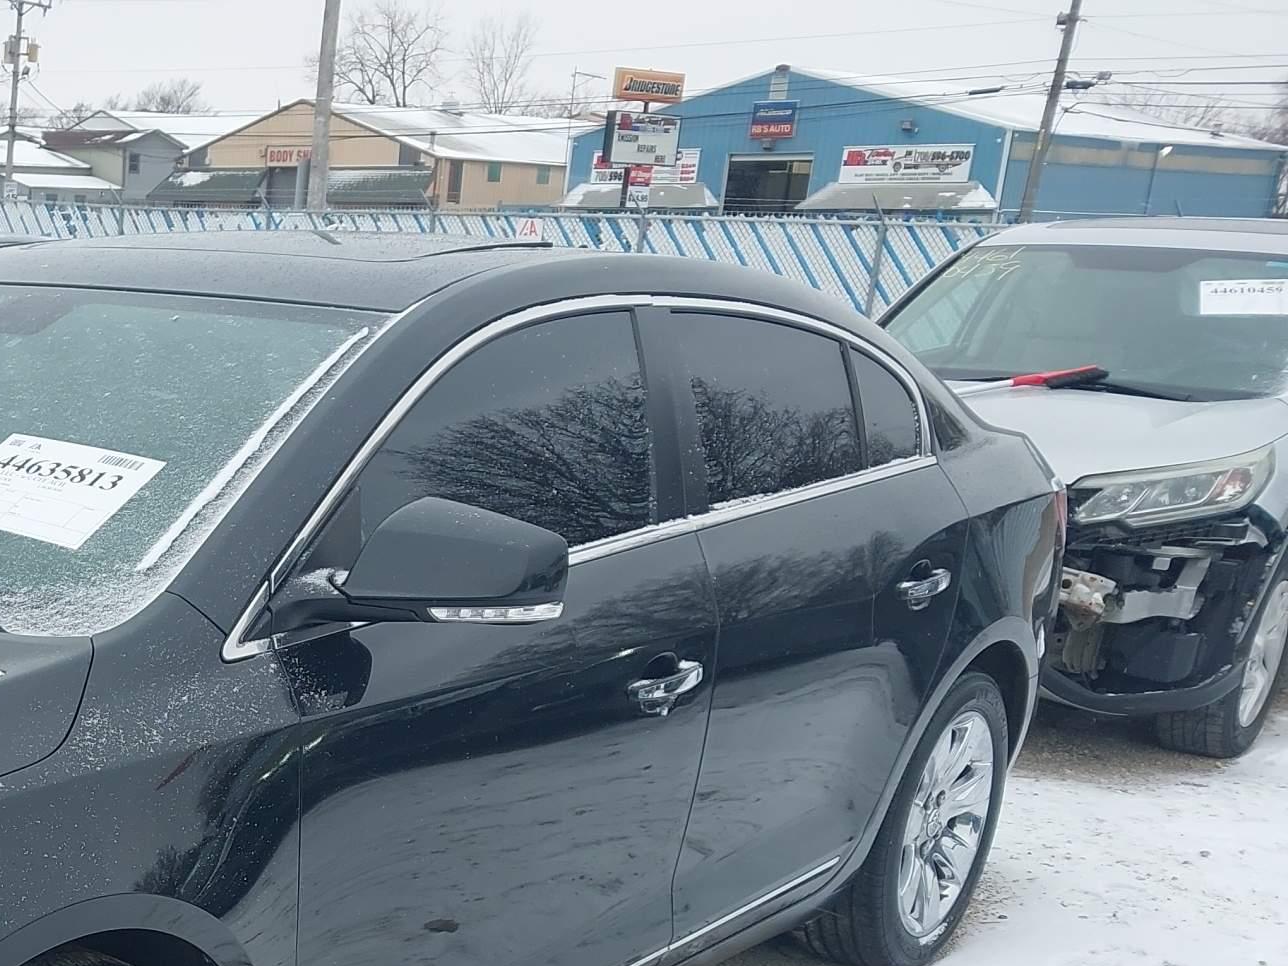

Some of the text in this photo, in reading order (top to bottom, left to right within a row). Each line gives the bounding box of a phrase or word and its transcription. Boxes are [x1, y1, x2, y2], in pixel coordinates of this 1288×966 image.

[623, 75, 681, 96] BRIDGESTONE
[769, 124, 791, 133] AUTO
[270, 150, 312, 162] BODY SH
